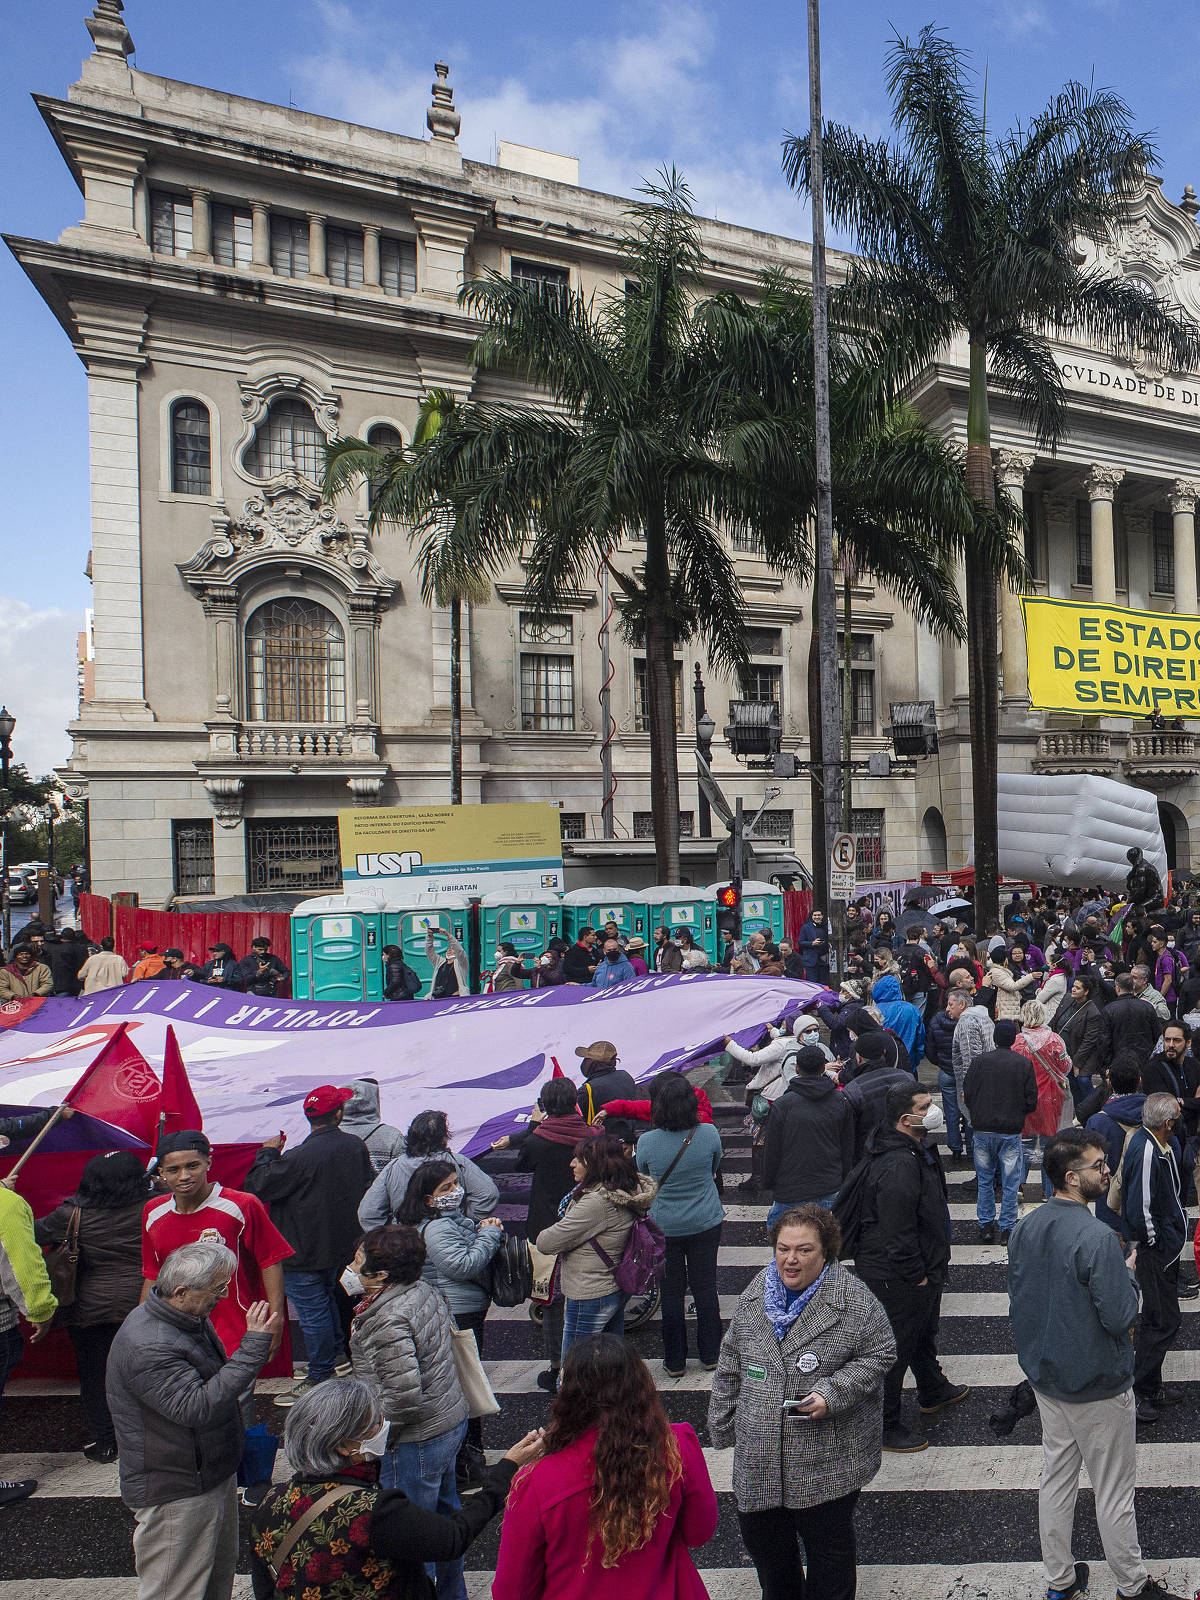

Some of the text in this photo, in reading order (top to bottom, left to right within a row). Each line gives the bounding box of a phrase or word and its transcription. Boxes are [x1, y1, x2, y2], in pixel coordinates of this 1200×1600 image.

[1061, 364, 1147, 396] CVLDADE
[1154, 384, 1175, 401] DE
[1053, 646, 1101, 672] DE
[356, 850, 423, 876] USP
[441, 884, 478, 892] UBIRATAN
[433, 989, 555, 1017] PODER
[225, 1004, 382, 1029] POPULAR
